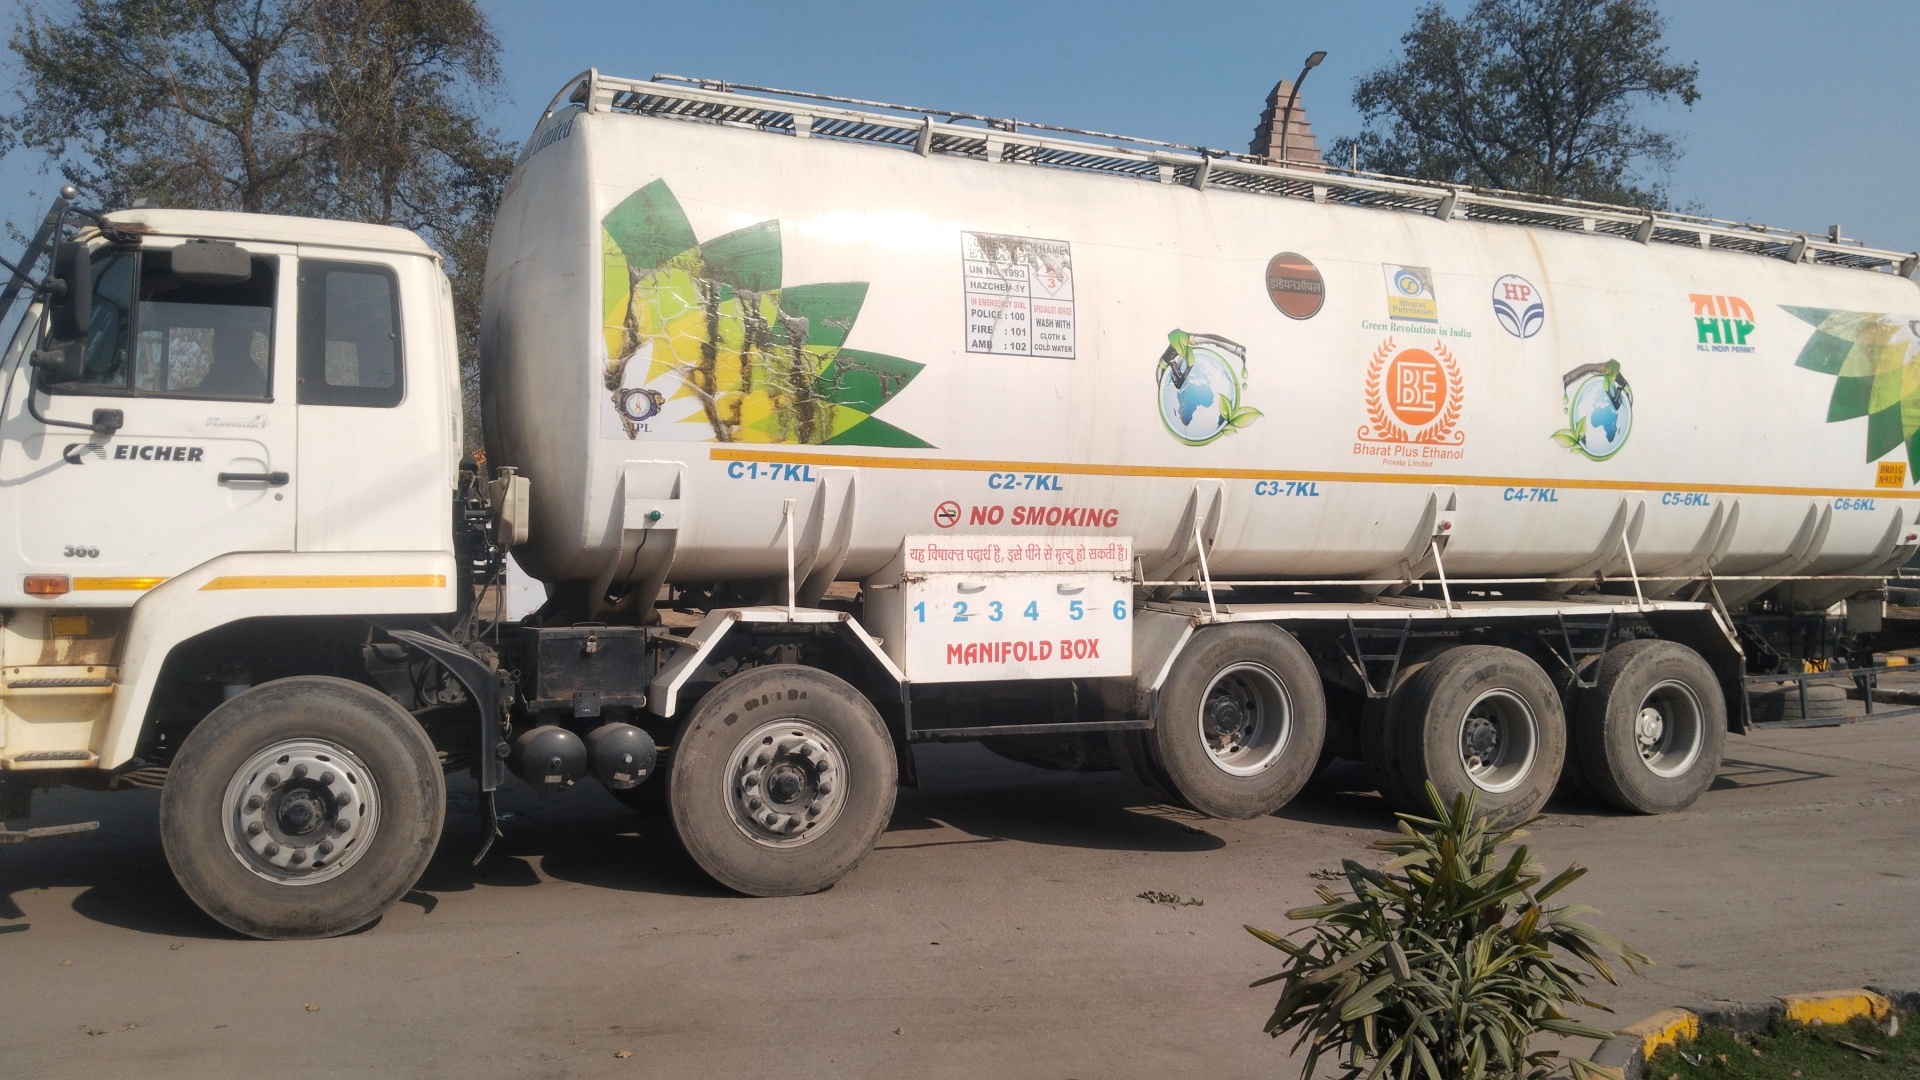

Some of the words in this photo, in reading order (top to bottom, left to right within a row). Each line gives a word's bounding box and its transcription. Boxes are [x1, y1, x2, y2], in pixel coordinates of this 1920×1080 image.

[969, 265, 983, 275] UN
[1004, 269, 1025, 278] 1993
[1047, 278, 1056, 288] 3
[1502, 282, 1531, 302] HP
[971, 297, 977, 305] IN
[1013, 301, 1027, 309] DIAL
[1399, 299, 1426, 309] Bharat
[971, 308, 1003, 320] POLICE
[1009, 312, 1025, 321] 100
[1392, 305, 1434, 316] Petroleum
[971, 324, 994, 334] FIRE
[1010, 327, 1027, 336] 101
[1036, 317, 1054, 328] WASH
[1055, 319, 1071, 330] WITH
[1361, 319, 1388, 331] Green
[1390, 322, 1437, 335] Revolution
[1439, 326, 1448, 336] in
[1449, 327, 1472, 338] India
[1040, 332, 1060, 341] CLOTH
[1061, 333, 1066, 341] &
[971, 339, 993, 349] AMB
[1009, 342, 1027, 351] 102
[1052, 345, 1073, 353] WATER
[1696, 344, 1710, 352] ALL
[1711, 345, 1730, 353] INDIA
[1731, 346, 1755, 354] PERMIT
[114, 444, 204, 462] EICHER
[1353, 442, 1391, 456] Bharat
[1394, 445, 1419, 458] Plus
[1422, 446, 1464, 459] Ethanol
[1382, 458, 1406, 467] Private
[1408, 460, 1433, 468] Limited
[727, 461, 816, 483] C1-7KL
[988, 473, 1063, 491] C2-7KL
[1254, 481, 1320, 497] C3-7KL
[1503, 487, 1559, 503] C4-7KL
[1661, 492, 1710, 507] C5-6KL
[1834, 497, 1876, 511] C6-6KL
[969, 506, 1005, 526] NO
[1010, 507, 1120, 528] SMOKING
[63, 544, 100, 559] 300
[909, 548, 926, 563] यह
[927, 543, 964, 561] विषाक्त
[967, 544, 992, 562] पदार्थ
[1007, 544, 1022, 562] इसे
[1025, 543, 1041, 560] पीने
[1043, 544, 1053, 560] से
[1055, 548, 1075, 565] मृत्यु
[1076, 544, 1086, 562] हो
[1089, 543, 1115, 560] सकती
[913, 601, 926, 622] 1
[952, 601, 969, 622] 2
[988, 600, 1004, 622] 3
[1023, 600, 1039, 621] 4
[1069, 600, 1084, 621] 5
[1112, 600, 1127, 620] 6
[946, 641, 1053, 666] MANIFOLD
[1060, 638, 1100, 660] BOX
